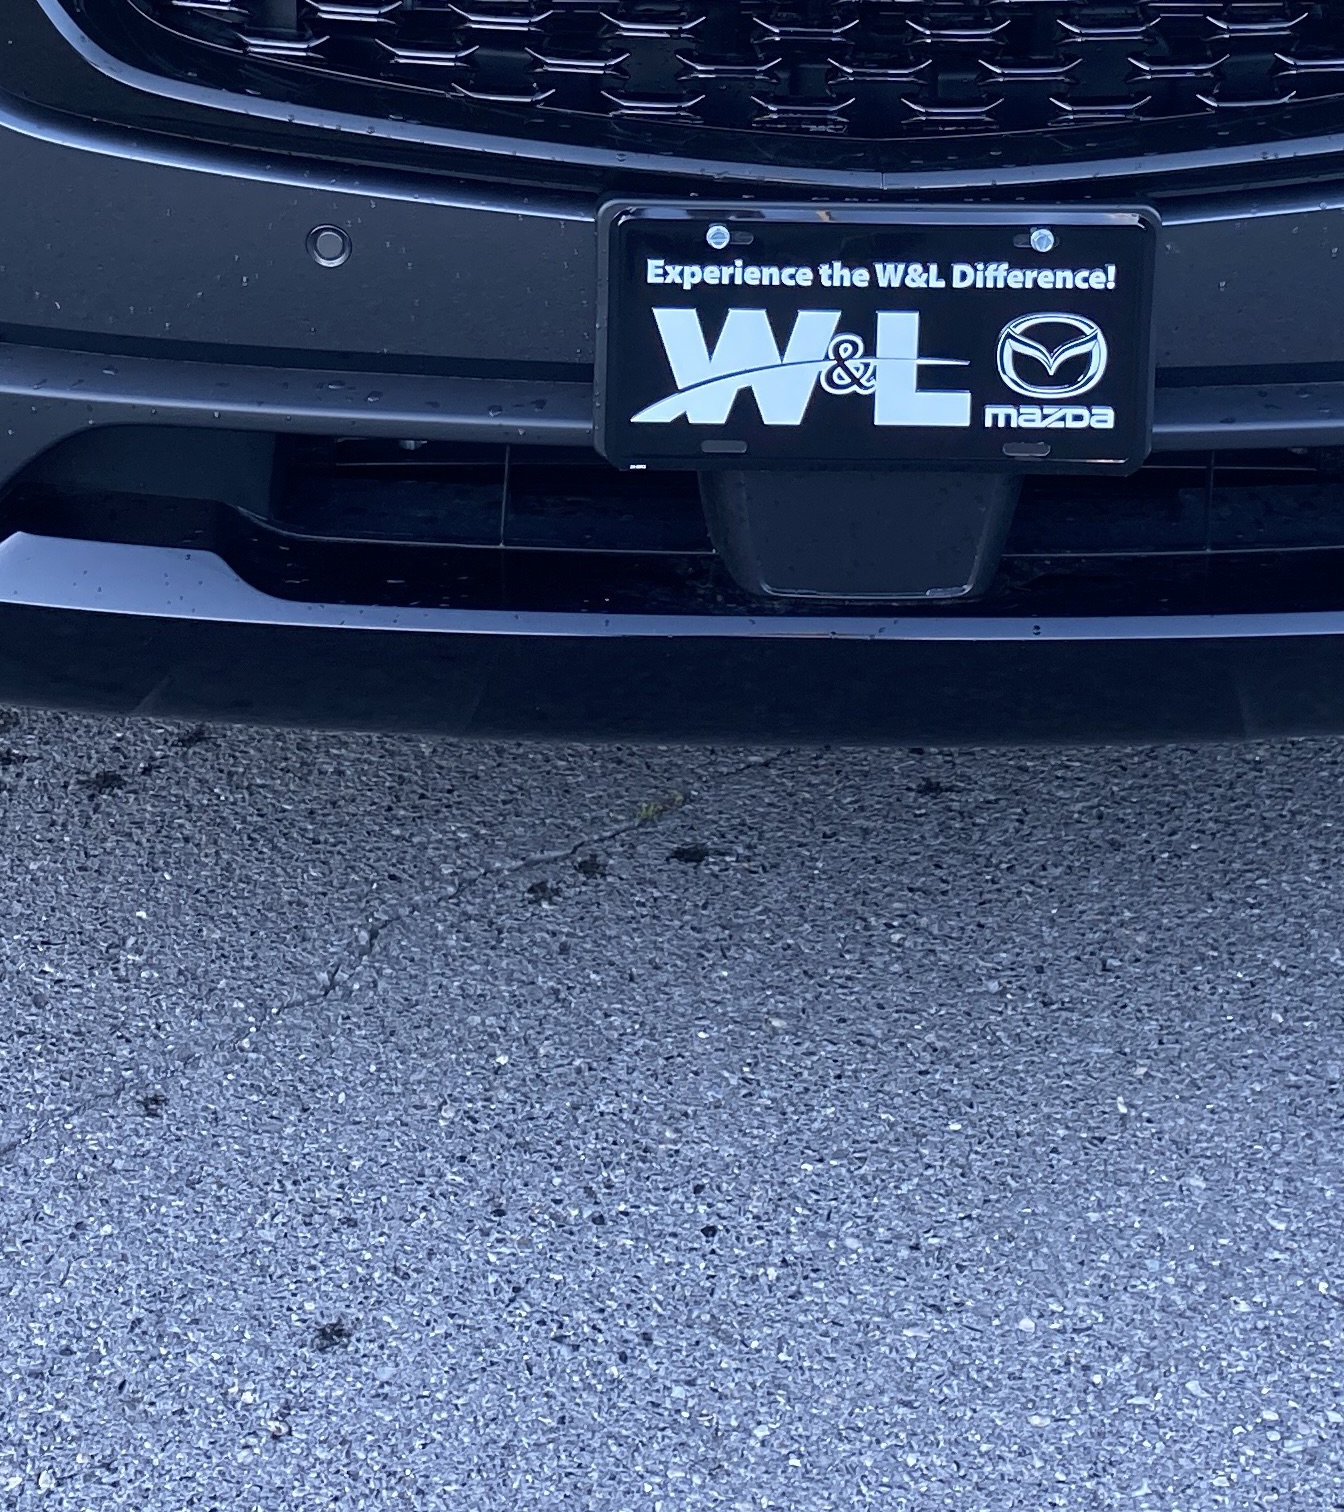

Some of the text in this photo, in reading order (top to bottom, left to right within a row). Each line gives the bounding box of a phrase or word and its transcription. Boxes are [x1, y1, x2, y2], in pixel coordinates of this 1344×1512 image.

[646, 258, 1116, 290] Experience the W&L Difference!
[629, 306, 972, 427] W&L
